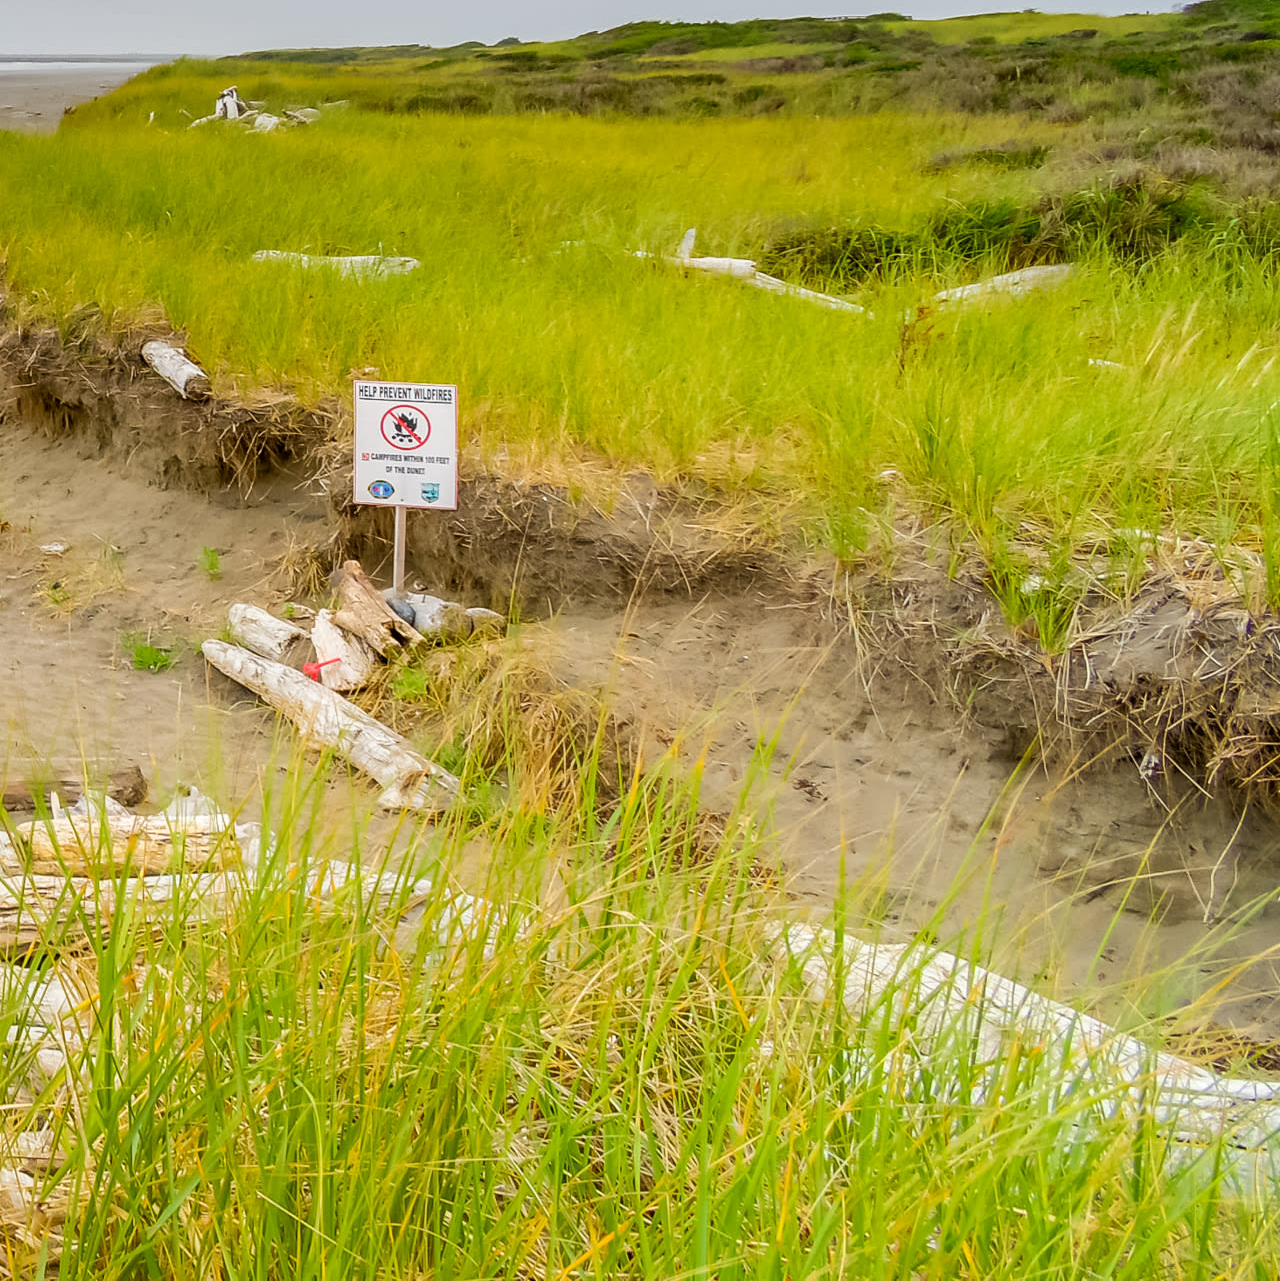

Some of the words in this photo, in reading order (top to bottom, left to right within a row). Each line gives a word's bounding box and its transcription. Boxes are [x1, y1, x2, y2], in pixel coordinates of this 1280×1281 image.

[359, 385, 377, 397] HELP
[379, 386, 412, 399] PREVENT
[414, 387, 453, 401] WILDFIRES
[370, 453, 402, 462] CAMPFIRES
[403, 455, 424, 463] WITHIN
[436, 456, 450, 464] FEET
[394, 466, 405, 474] THE
